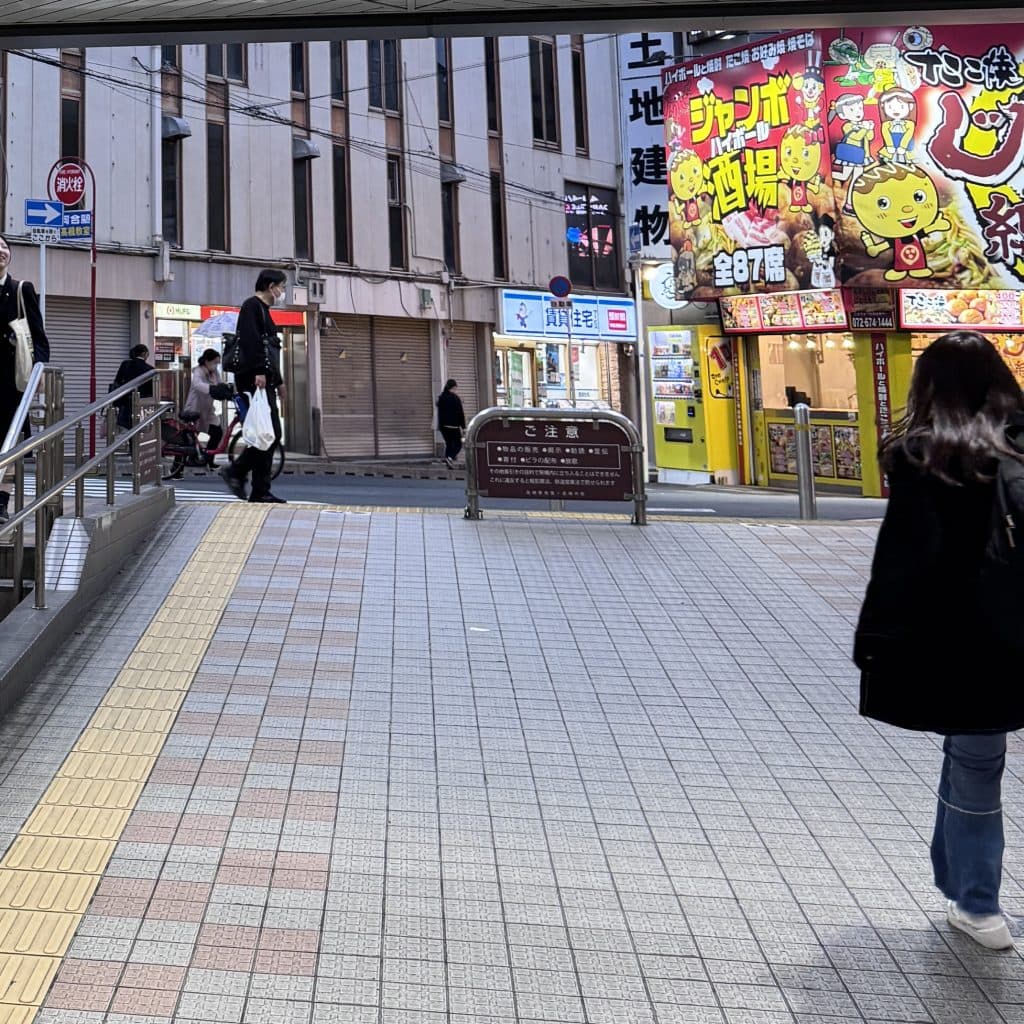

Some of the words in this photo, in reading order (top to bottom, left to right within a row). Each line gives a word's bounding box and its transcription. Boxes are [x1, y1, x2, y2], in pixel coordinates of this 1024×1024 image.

[689, 70, 793, 144] ジャンボ
[711, 121, 770, 156] ハイボール
[56, 176, 83, 192] 消火栓
[704, 148, 778, 224] 酒場
[713, 244, 786, 287] 全87席
[524, 424, 580, 439] ご注意
